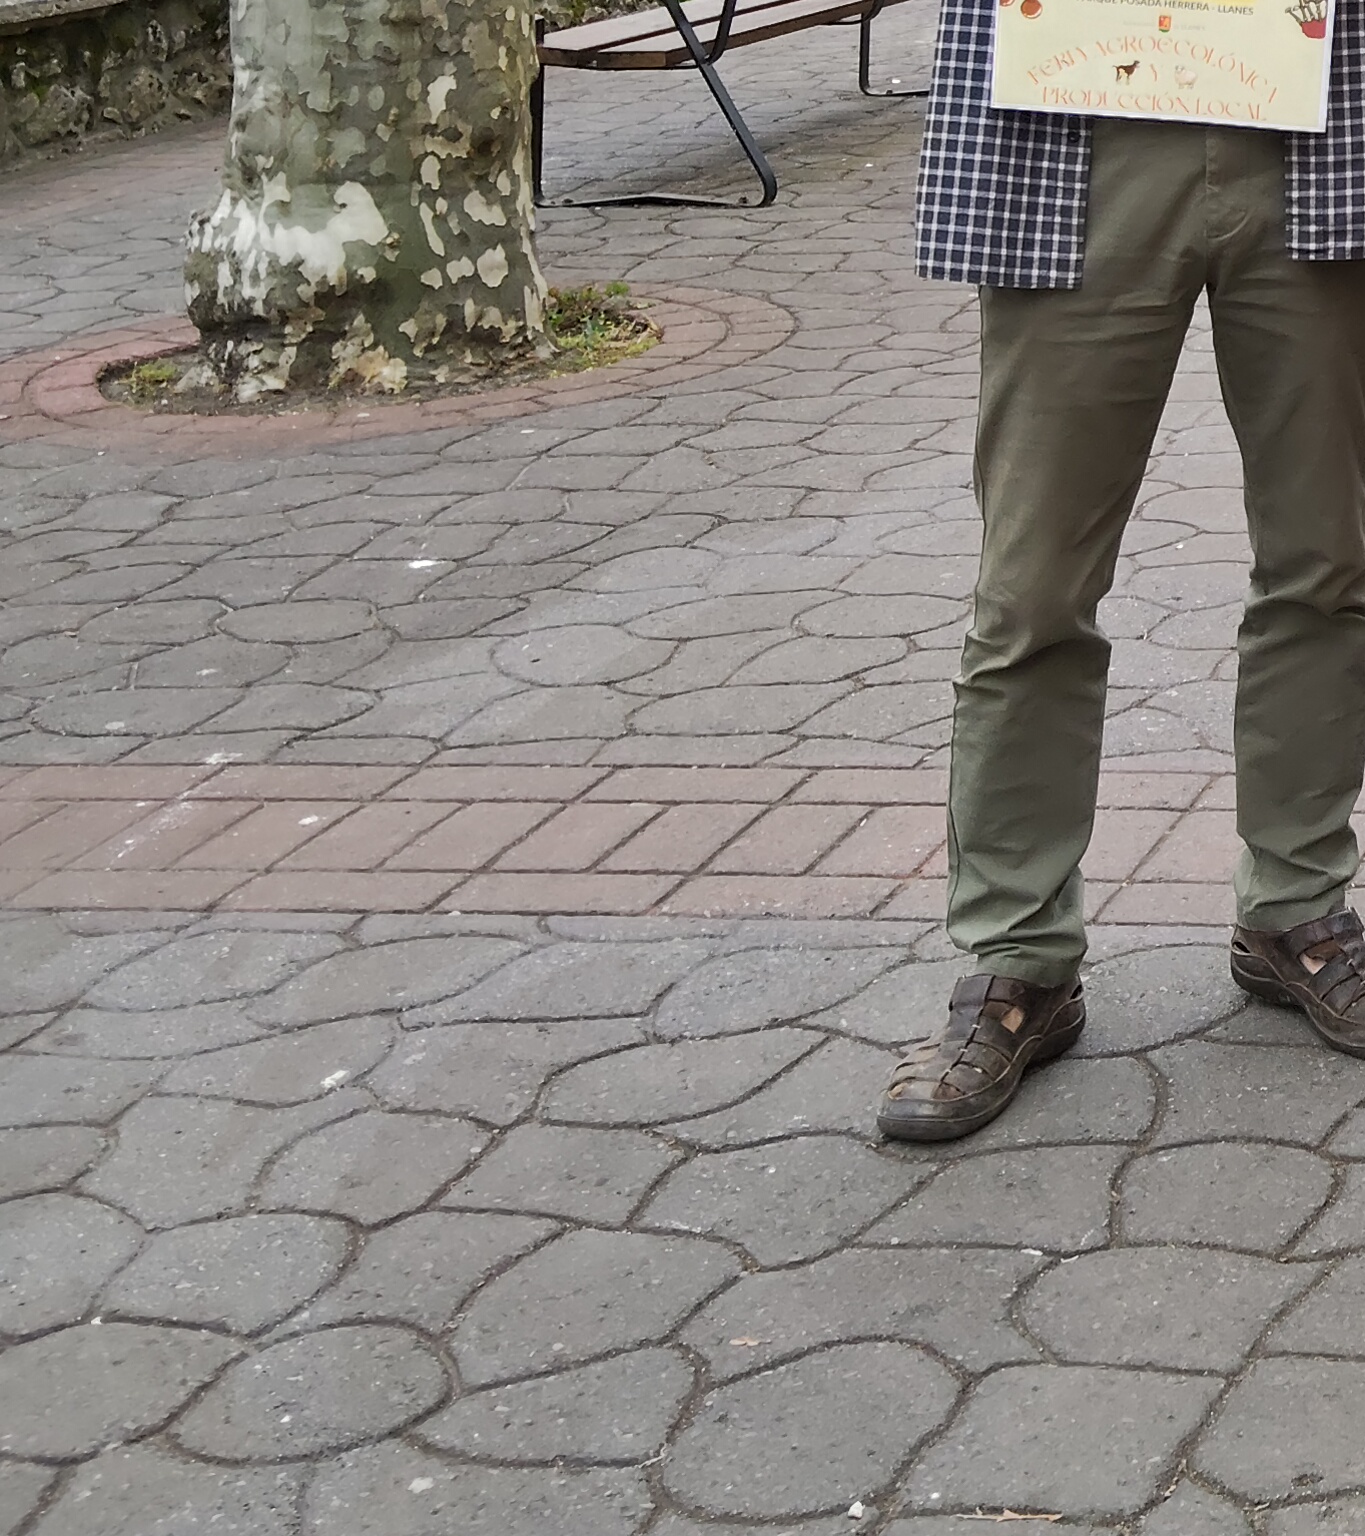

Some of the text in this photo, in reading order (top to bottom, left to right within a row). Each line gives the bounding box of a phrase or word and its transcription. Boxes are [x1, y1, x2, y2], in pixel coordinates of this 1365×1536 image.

[1164, 0, 1210, 11] HERRERA
[1217, 4, 1254, 15] LLANES
[1025, 43, 1090, 89] FERIA
